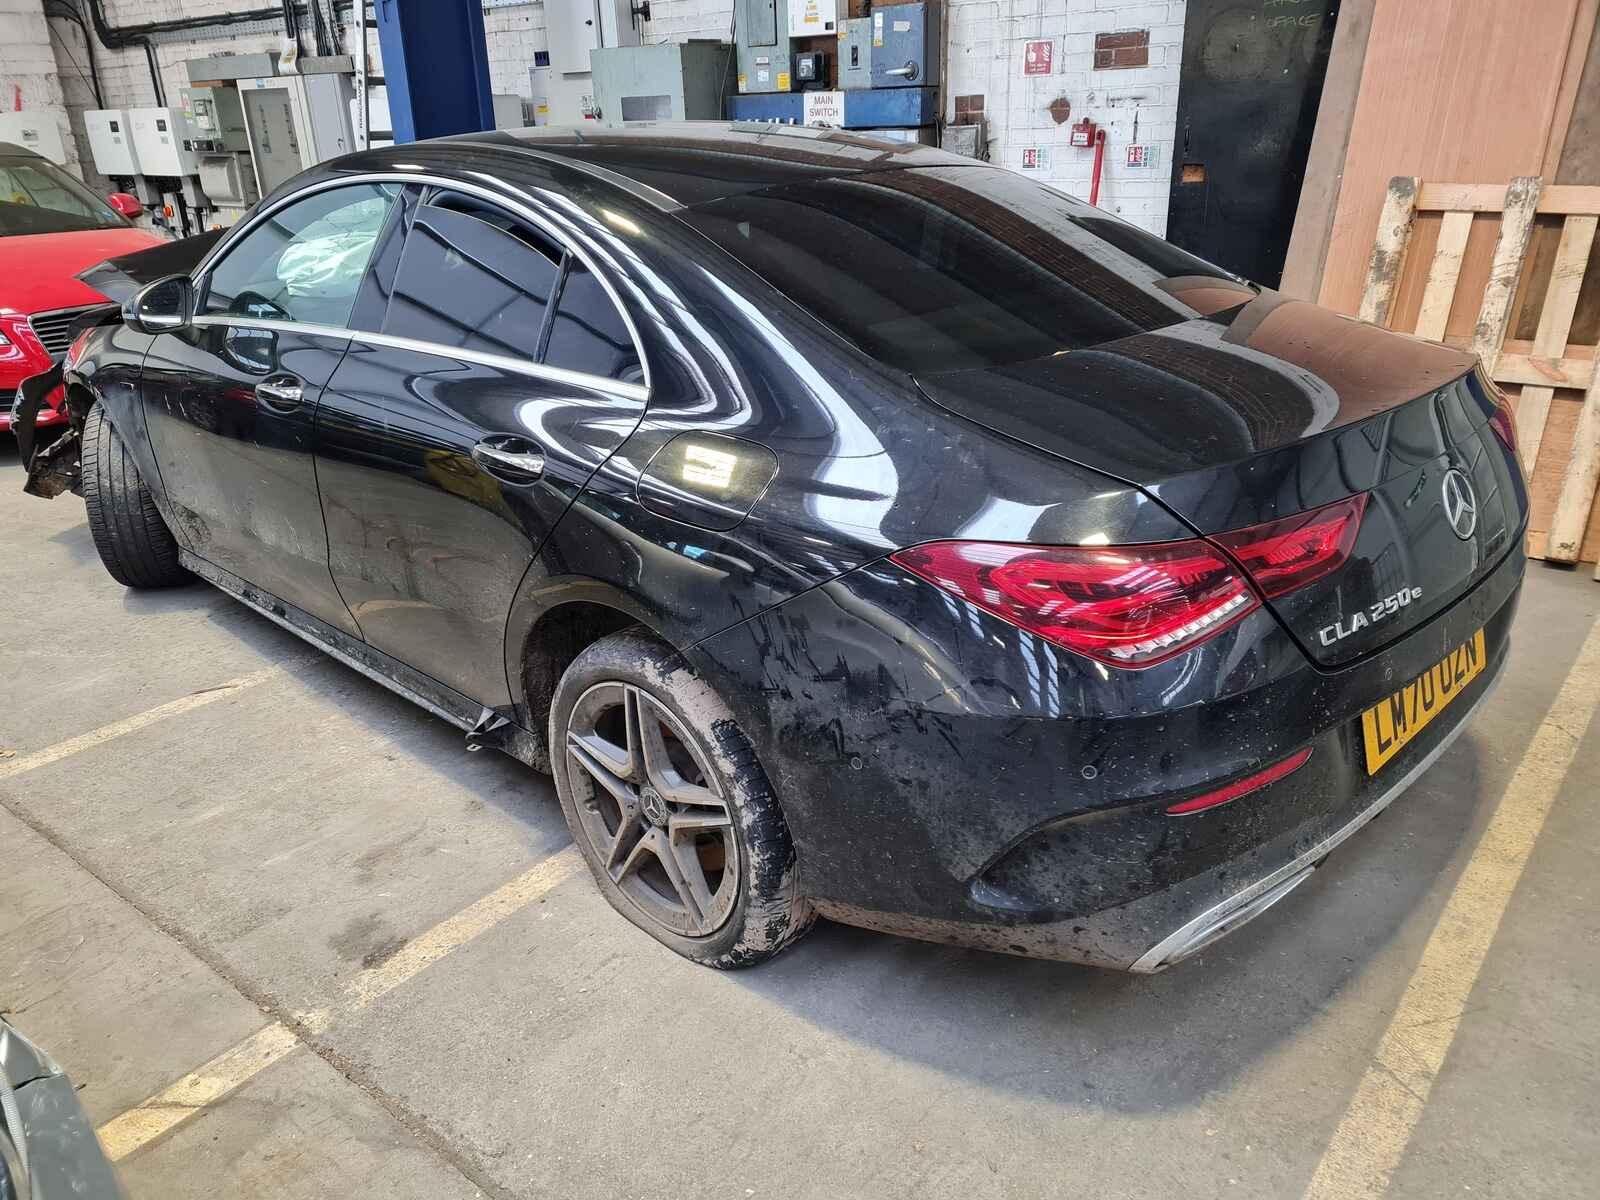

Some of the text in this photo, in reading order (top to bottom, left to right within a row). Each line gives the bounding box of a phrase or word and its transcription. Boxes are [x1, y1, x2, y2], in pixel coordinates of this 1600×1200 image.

[809, 107, 839, 117] SWITCH
[814, 95, 833, 105] MAIN
[1319, 586, 1422, 646] CLA 250e
[1373, 670, 1435, 756] LM70
